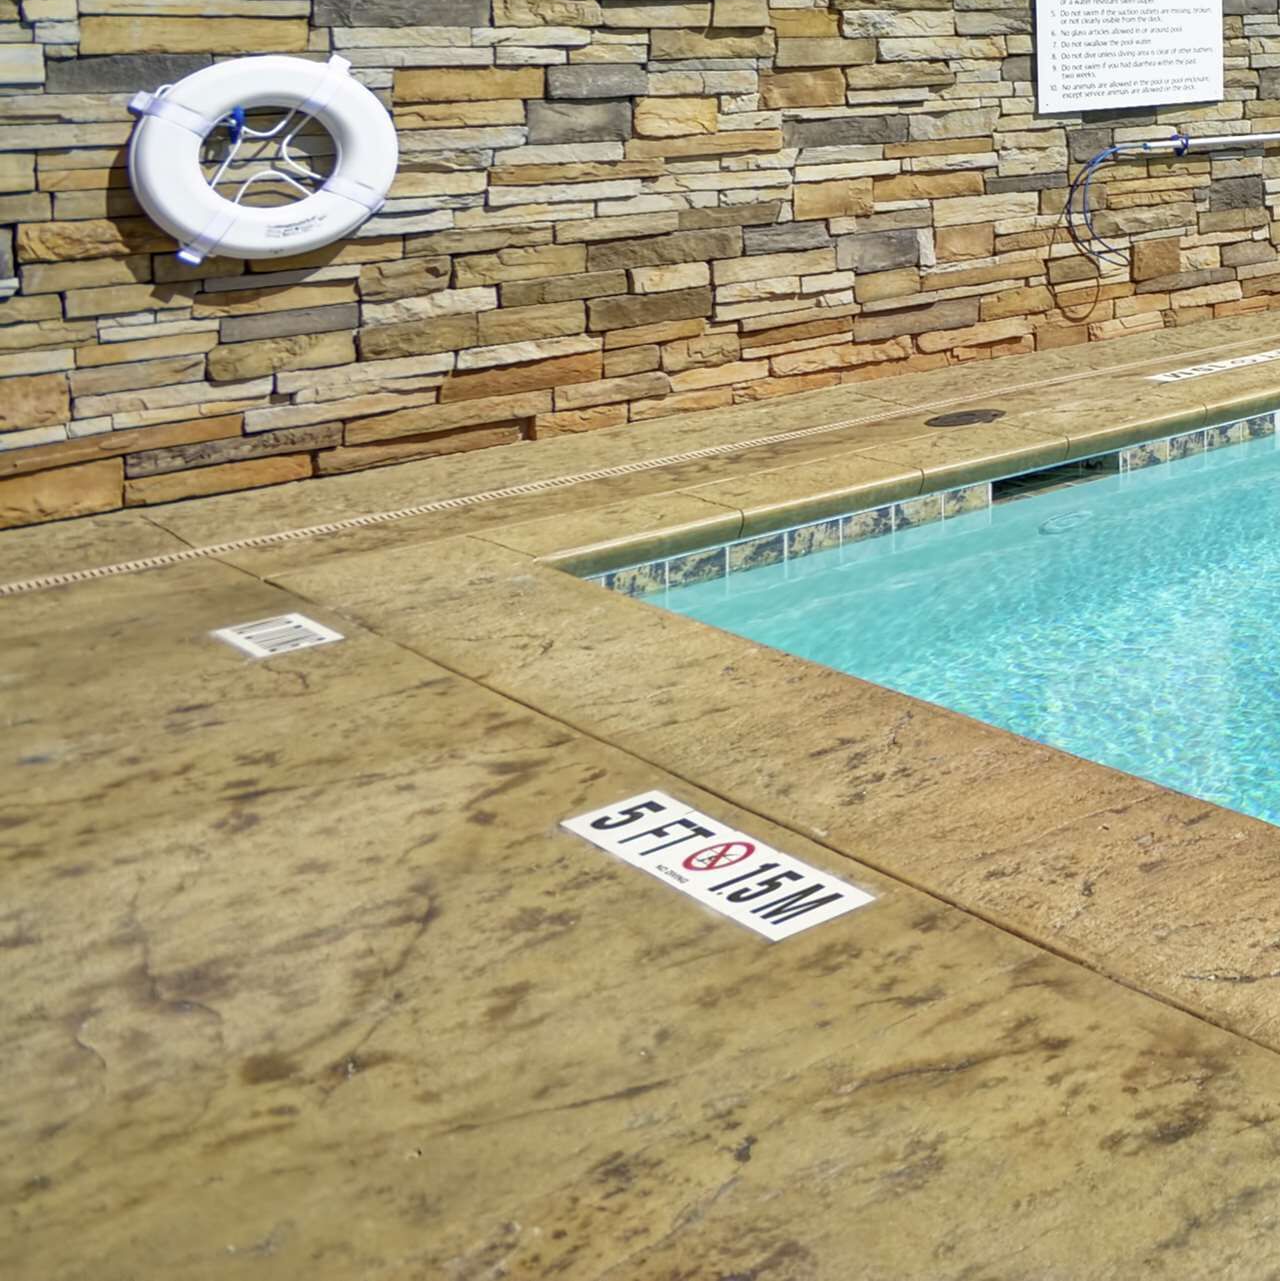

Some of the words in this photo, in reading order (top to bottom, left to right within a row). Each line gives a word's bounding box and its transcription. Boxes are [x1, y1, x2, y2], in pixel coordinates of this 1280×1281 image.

[590, 800, 667, 831] 5
[617, 817, 716, 856] FT
[749, 883, 844, 925] M
